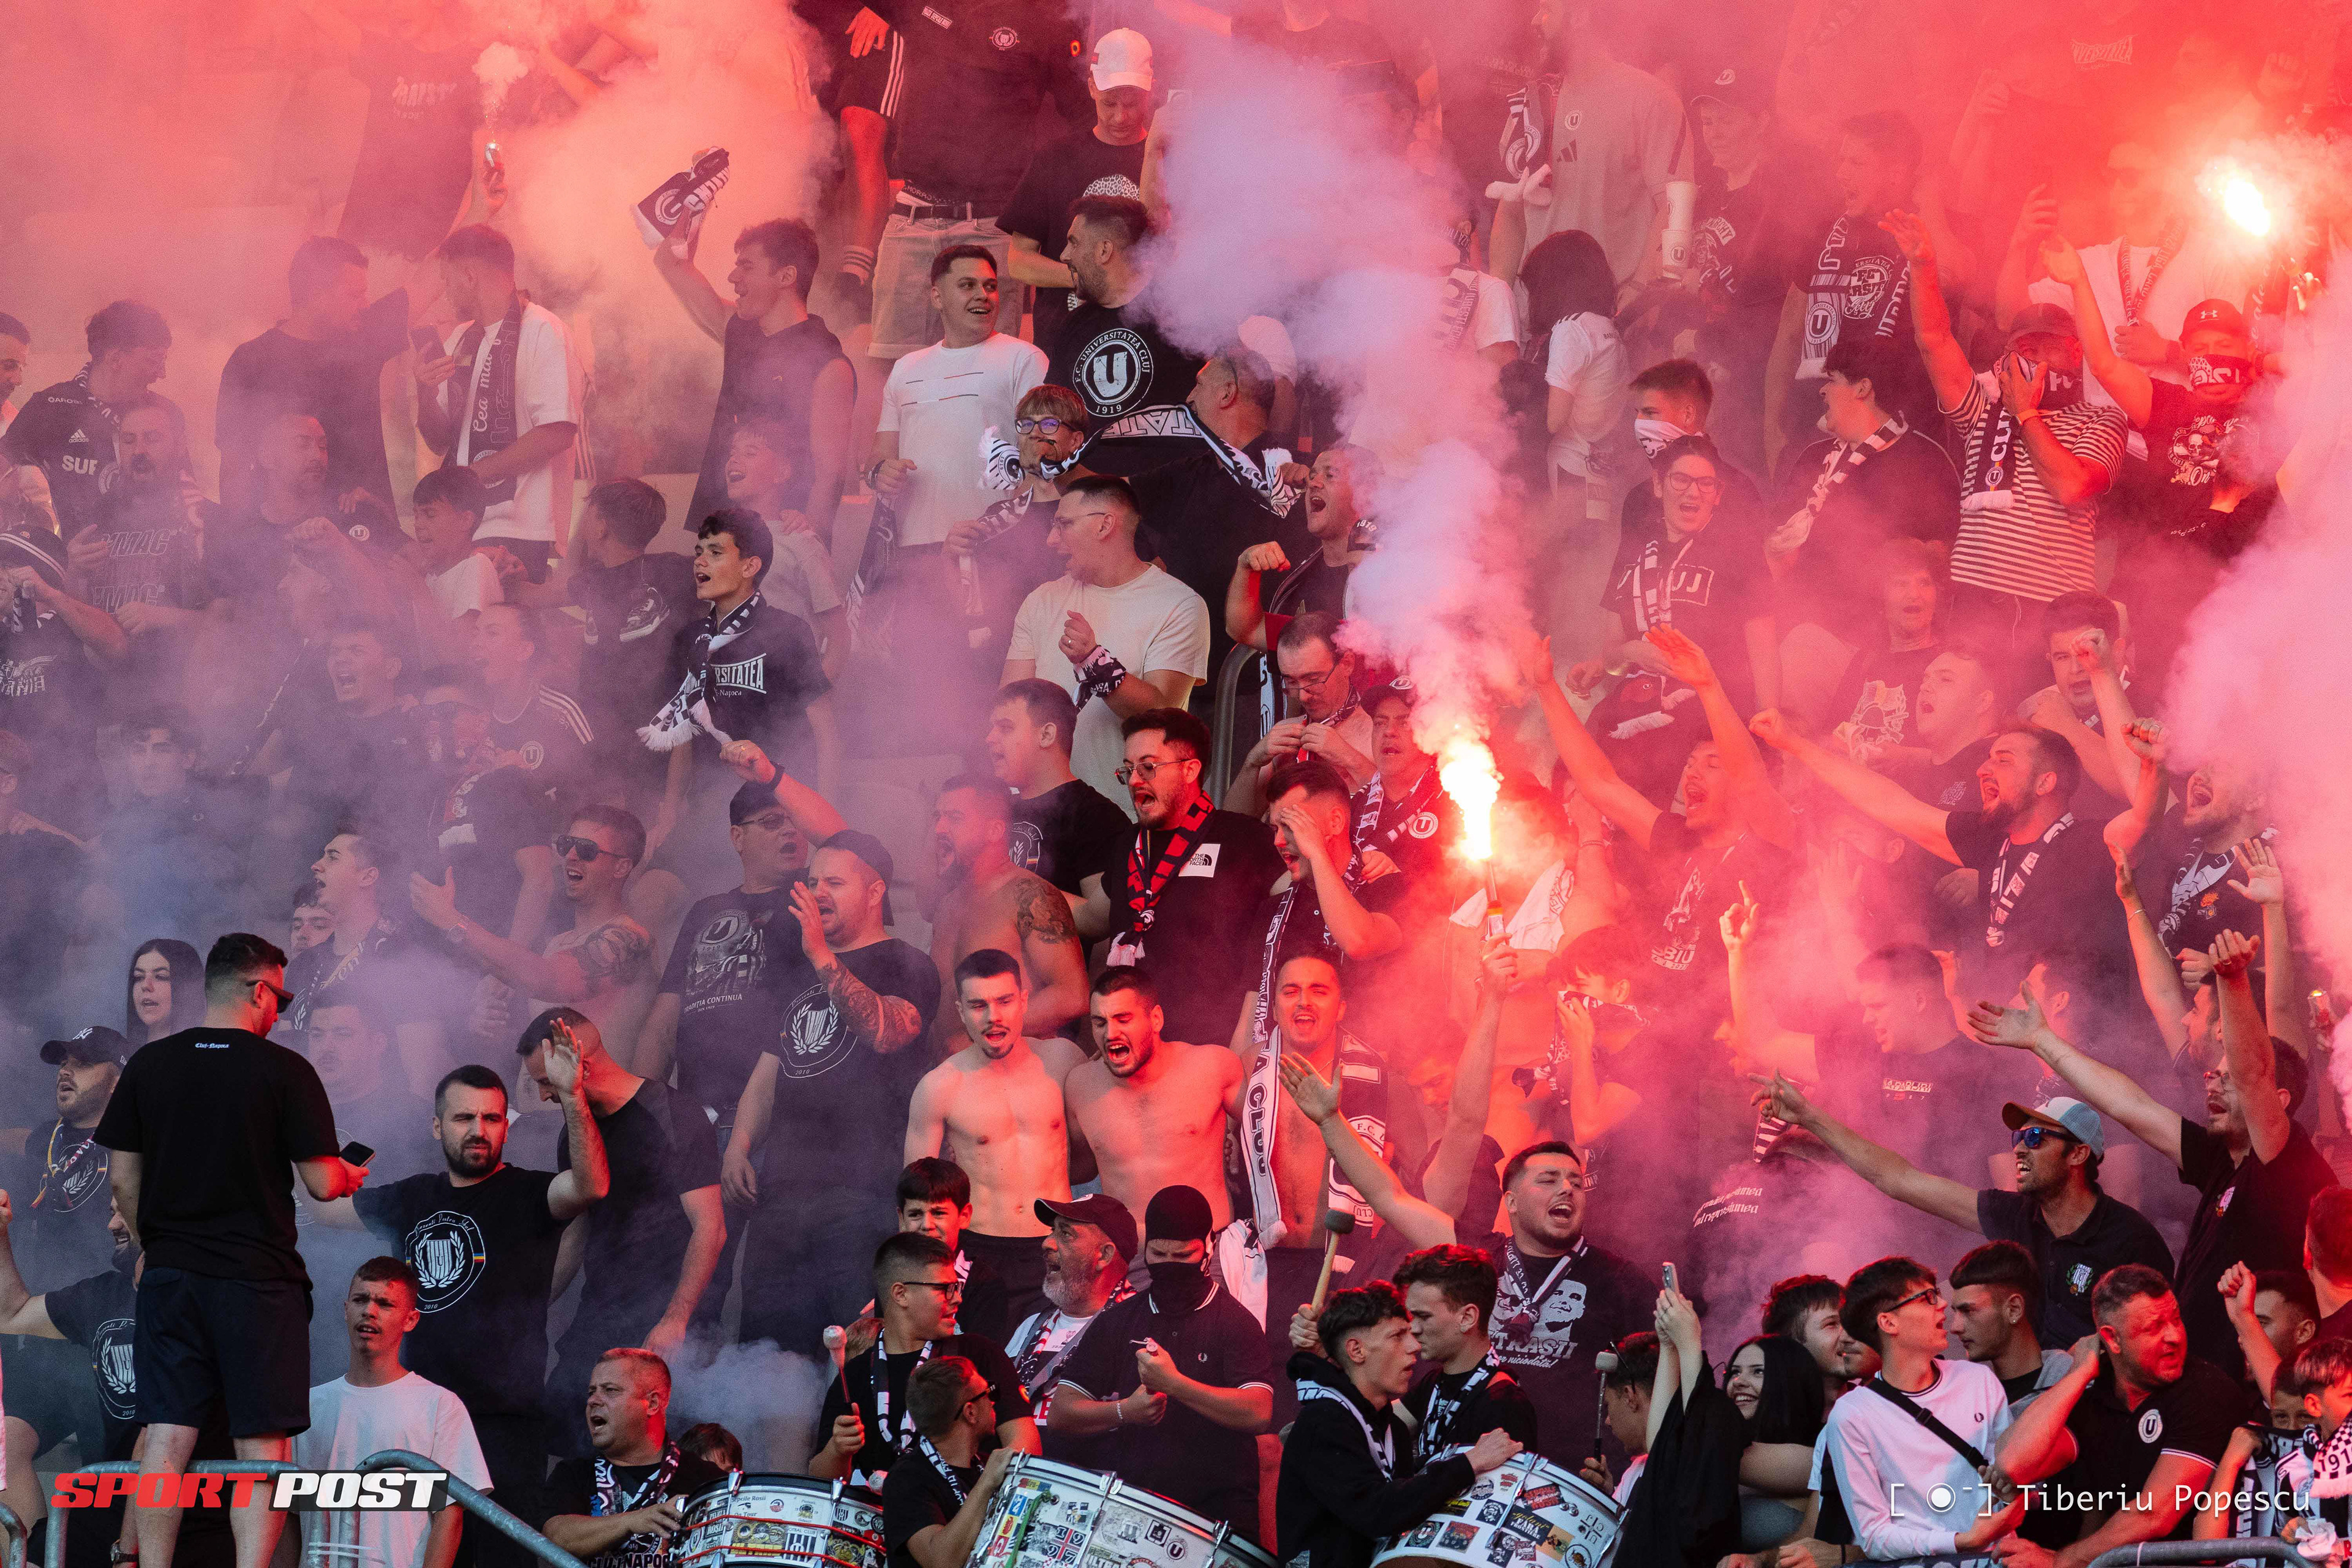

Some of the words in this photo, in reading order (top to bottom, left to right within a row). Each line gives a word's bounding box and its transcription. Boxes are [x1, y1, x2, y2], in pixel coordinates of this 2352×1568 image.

[1855, 258, 1891, 269] ERSITATEA
[1812, 314, 1830, 335] U
[1080, 331, 1141, 361] UNIVERSITATEA
[1139, 349, 1151, 373] CLUJ
[1093, 352, 1128, 398] U
[1096, 404, 1122, 414] 1919
[1991, 409, 2012, 462] CLU
[1356, 519, 1378, 532] 1919
[713, 658, 764, 690] RSITATEA
[1507, 1354, 1559, 1368] niciodată!
[2146, 1419, 2155, 1435] U
[2319, 1448, 2352, 1472] 191
